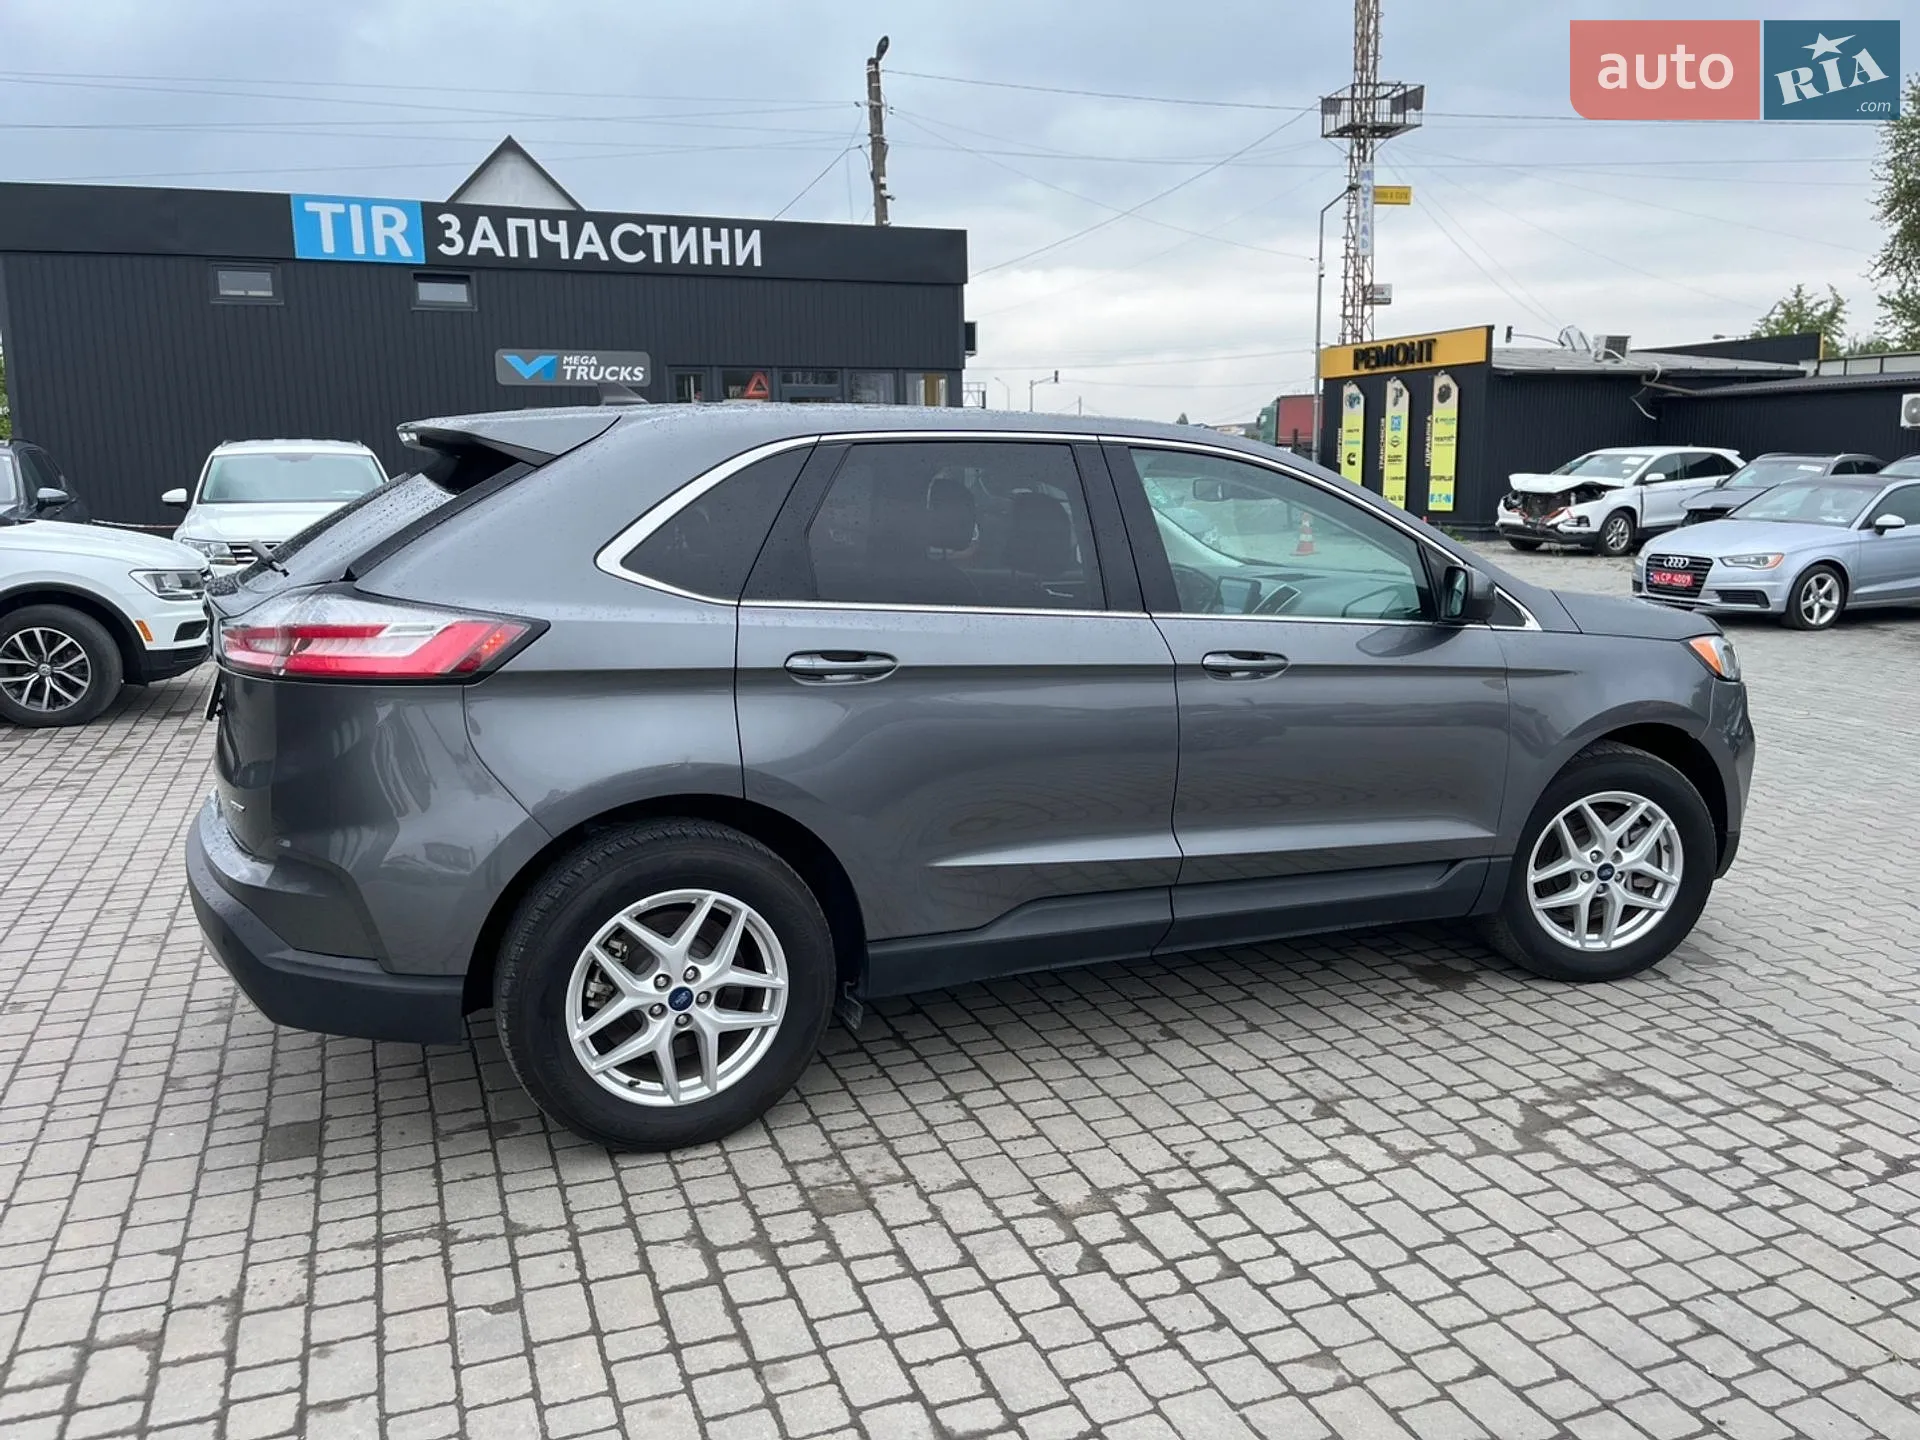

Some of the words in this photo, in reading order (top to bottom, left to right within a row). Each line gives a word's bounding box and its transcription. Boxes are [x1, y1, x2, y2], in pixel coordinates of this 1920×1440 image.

[304, 201, 413, 257] TIR
[437, 213, 762, 267] ЗАПЧАСТИНИ
[563, 355, 597, 366] MEGA
[1353, 338, 1437, 370] РЕМОНТ
[563, 365, 644, 382] TRUCKS
